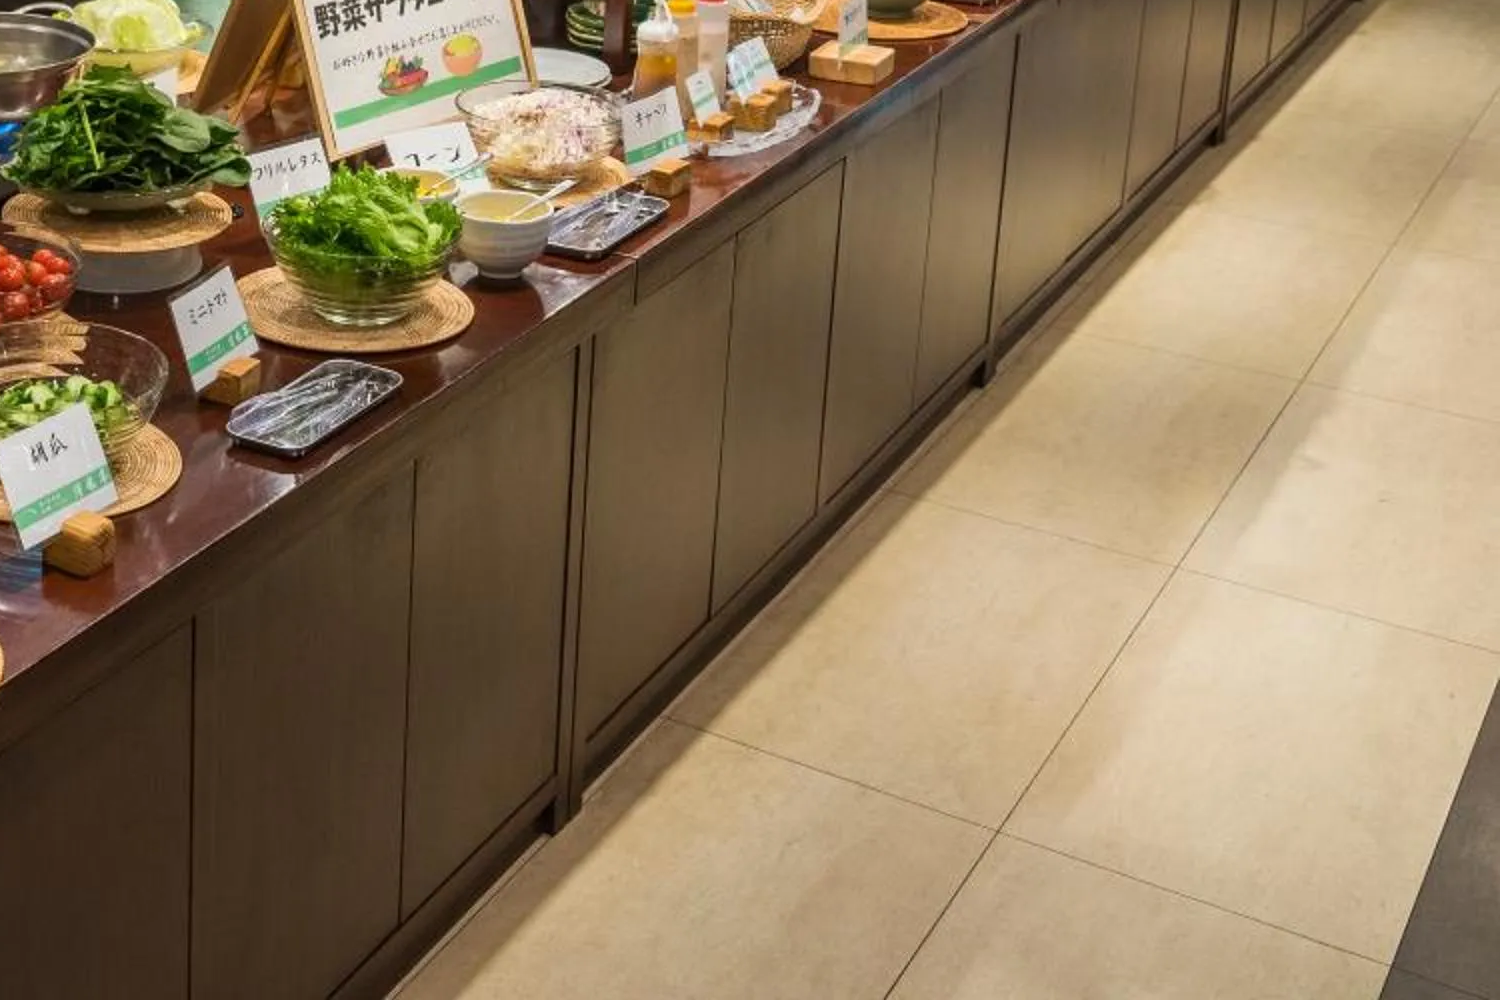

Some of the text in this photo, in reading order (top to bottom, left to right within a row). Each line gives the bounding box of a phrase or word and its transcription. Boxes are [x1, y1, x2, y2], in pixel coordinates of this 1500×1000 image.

[252, 151, 323, 181] フリルレタス
